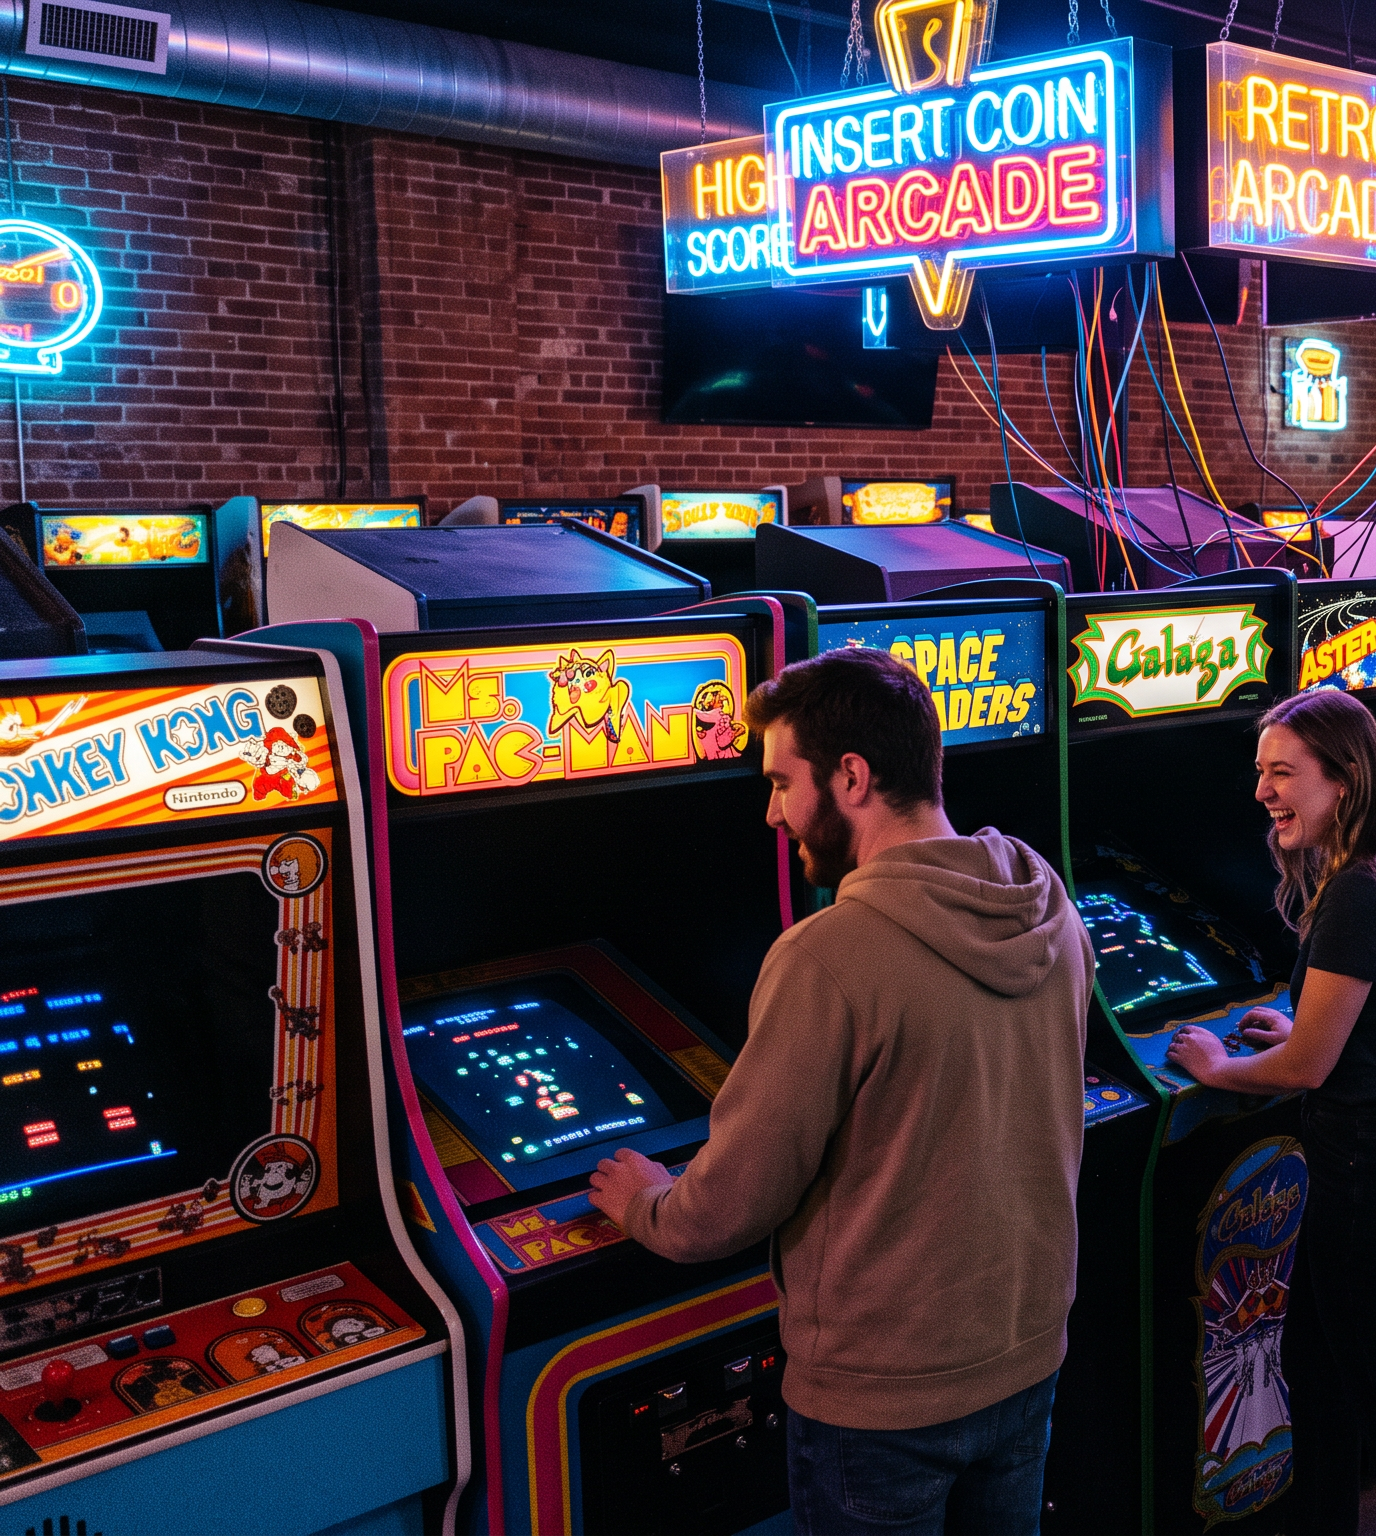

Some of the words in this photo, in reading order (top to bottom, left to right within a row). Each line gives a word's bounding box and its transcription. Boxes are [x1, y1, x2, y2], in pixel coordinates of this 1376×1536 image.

[790, 97, 955, 178] INSERT
[965, 71, 1097, 152] COIN
[799, 144, 1101, 257] ARCADE
[931, 678, 1037, 732] ADERS
[1105, 623, 1240, 702] Galaga
[0, 728, 130, 824] ONKEY
[135, 688, 266, 773] KONG
[416, 701, 697, 796] PAC-MAN
